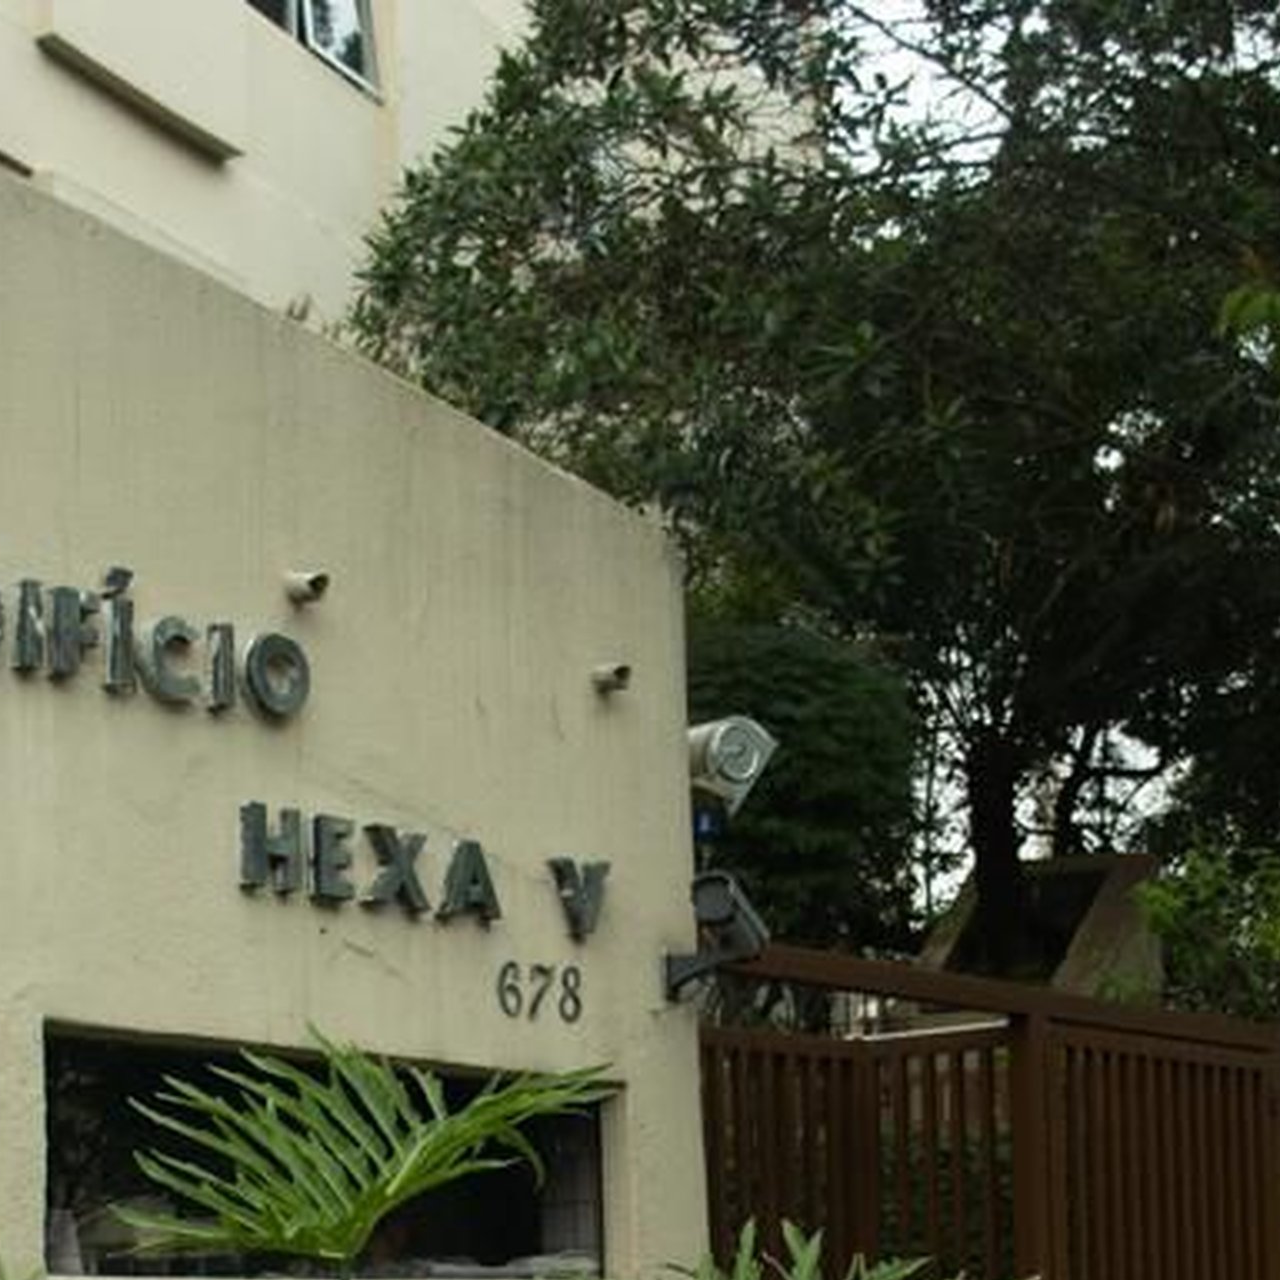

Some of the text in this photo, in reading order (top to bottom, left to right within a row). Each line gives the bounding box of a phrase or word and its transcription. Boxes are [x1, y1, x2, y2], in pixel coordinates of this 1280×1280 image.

[239, 801, 612, 941] HEXA V
[496, 961, 583, 1023] 678
